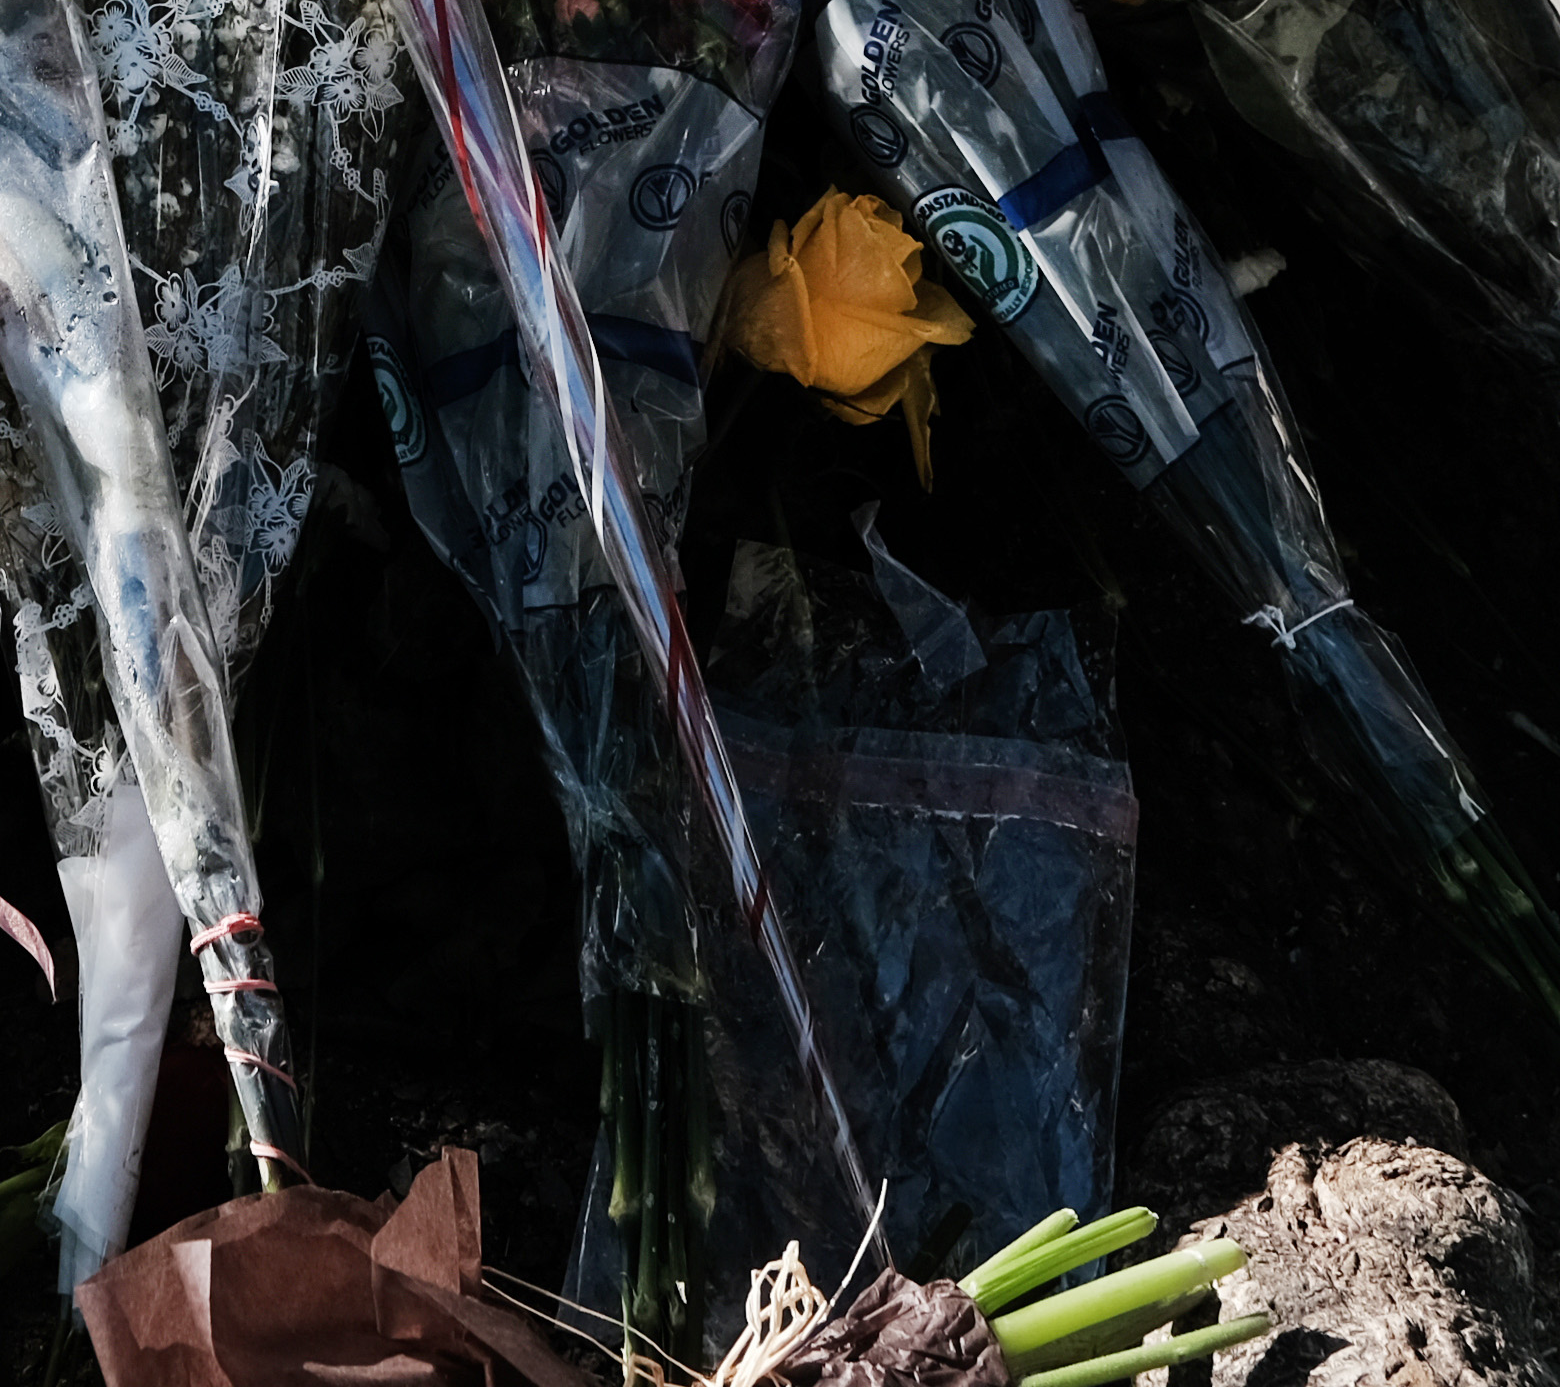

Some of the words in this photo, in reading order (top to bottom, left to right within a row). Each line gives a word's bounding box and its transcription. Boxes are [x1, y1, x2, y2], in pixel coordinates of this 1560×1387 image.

[861, 0, 903, 106] GOLDEN
[550, 93, 666, 156] GOLDEN
[579, 125, 651, 157] FLOWERS
[539, 472, 580, 524] GOL
